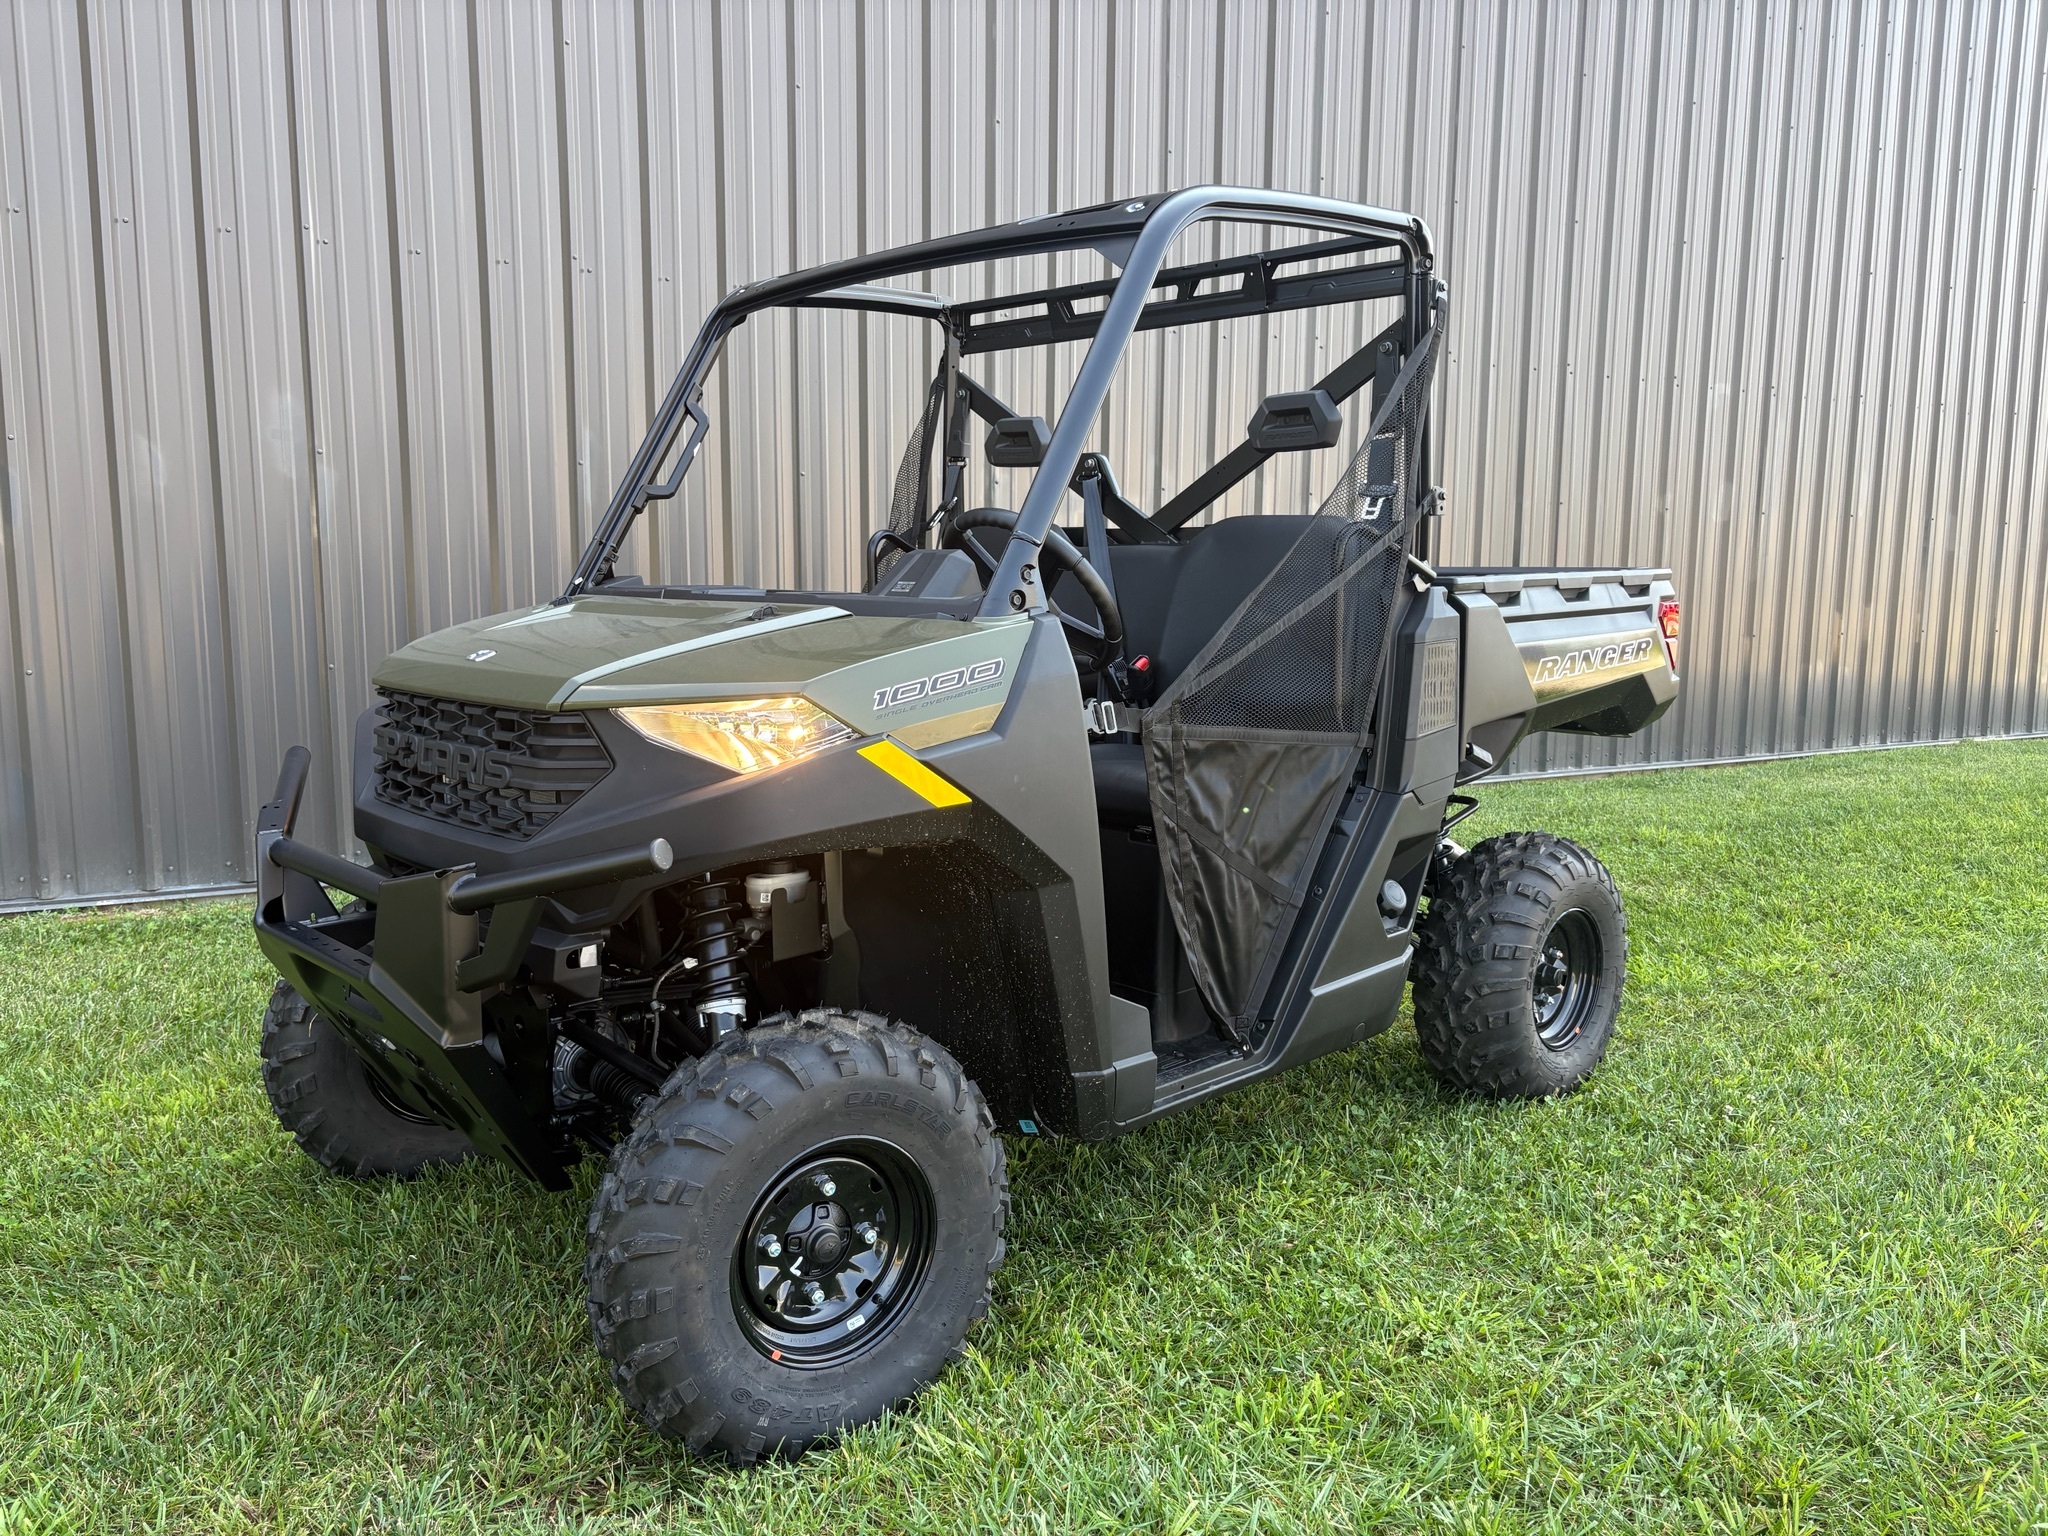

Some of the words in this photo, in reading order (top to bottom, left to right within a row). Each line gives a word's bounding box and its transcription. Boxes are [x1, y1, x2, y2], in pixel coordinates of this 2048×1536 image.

[873, 657, 1006, 711] 1000
[1533, 637, 1653, 684] RANGER
[875, 704, 918, 720] SINGLE
[921, 687, 979, 708] OVERHEAD
[980, 681, 1003, 693] CAM
[381, 727, 513, 789] POLARIS
[845, 1090, 952, 1140] CARLSTAR
[731, 1387, 840, 1424] AT489
